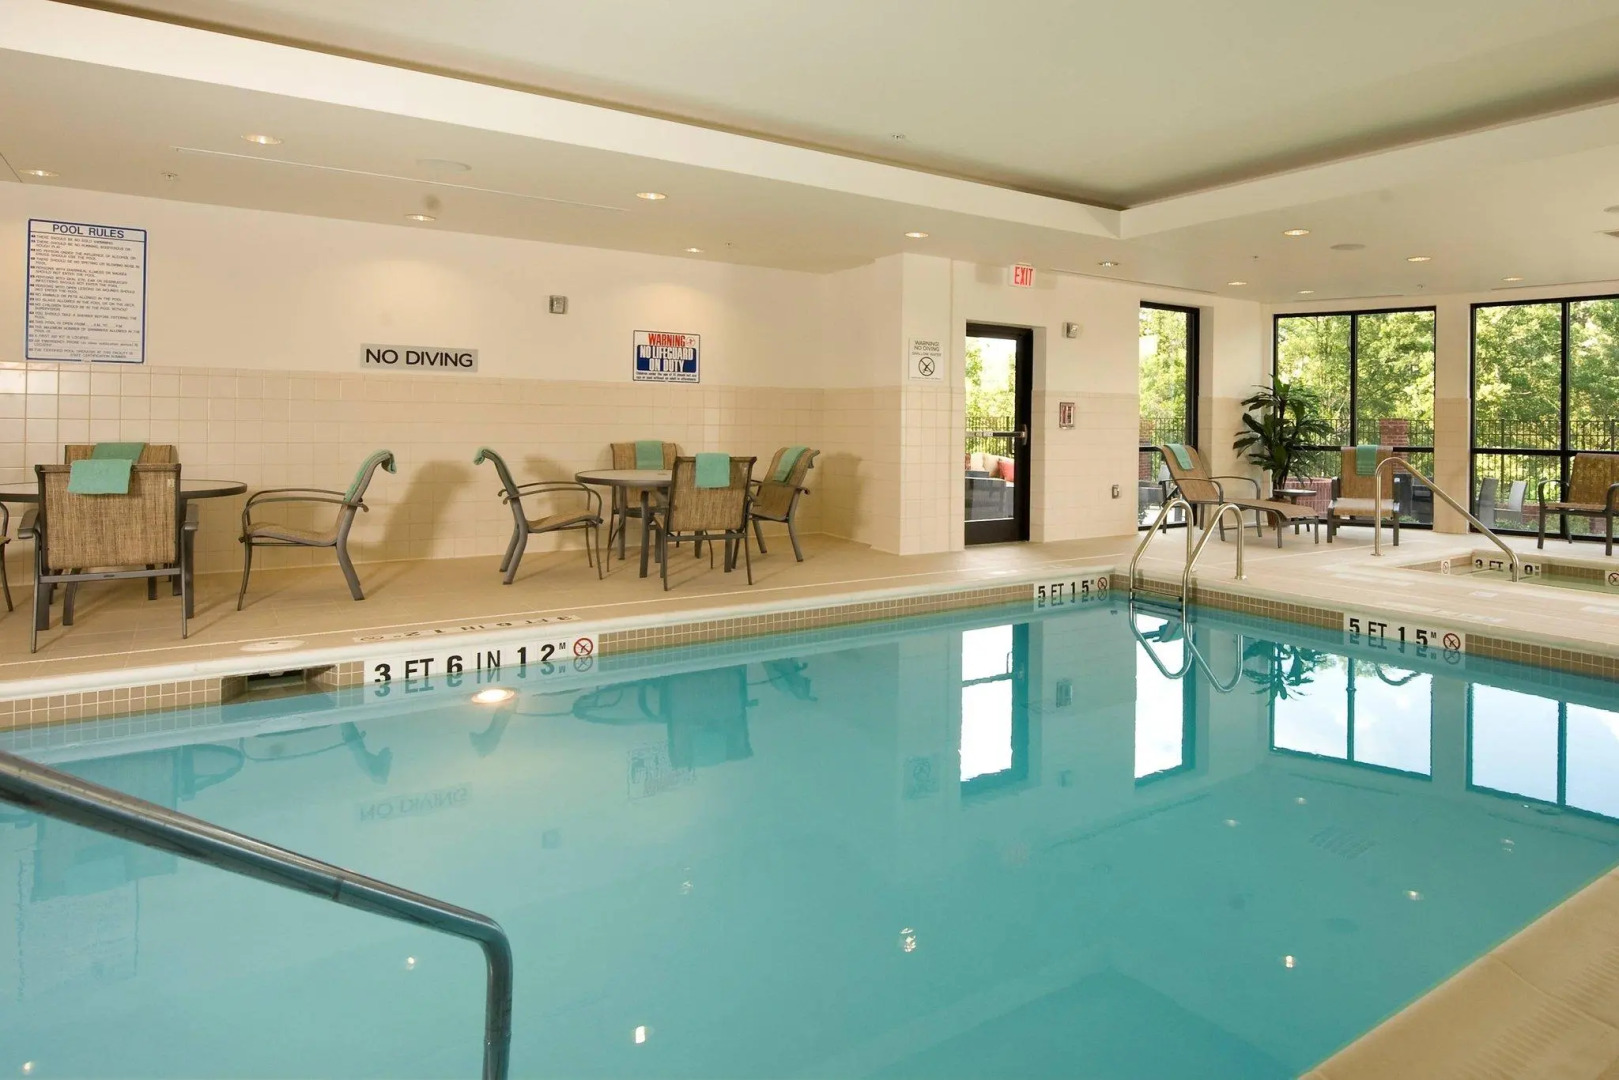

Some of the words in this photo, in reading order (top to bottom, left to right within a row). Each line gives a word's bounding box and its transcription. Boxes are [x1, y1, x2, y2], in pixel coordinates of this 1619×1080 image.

[52, 224, 84, 235] POOL
[88, 227, 125, 239] RULES
[1014, 266, 1034, 286] EXIT
[648, 333, 686, 347] WARNING
[366, 348, 399, 364] NO
[406, 350, 473, 368] DIVING
[639, 345, 651, 359] NO
[652, 346, 694, 361] LIFEGUARD
[649, 358, 661, 371] ON
[663, 359, 685, 373] DUTY
[1368, 621, 1387, 638] FT
[374, 663, 391, 683] 3
[405, 657, 434, 678] FT
[446, 655, 463, 673] 6
[476, 649, 501, 670] IN
